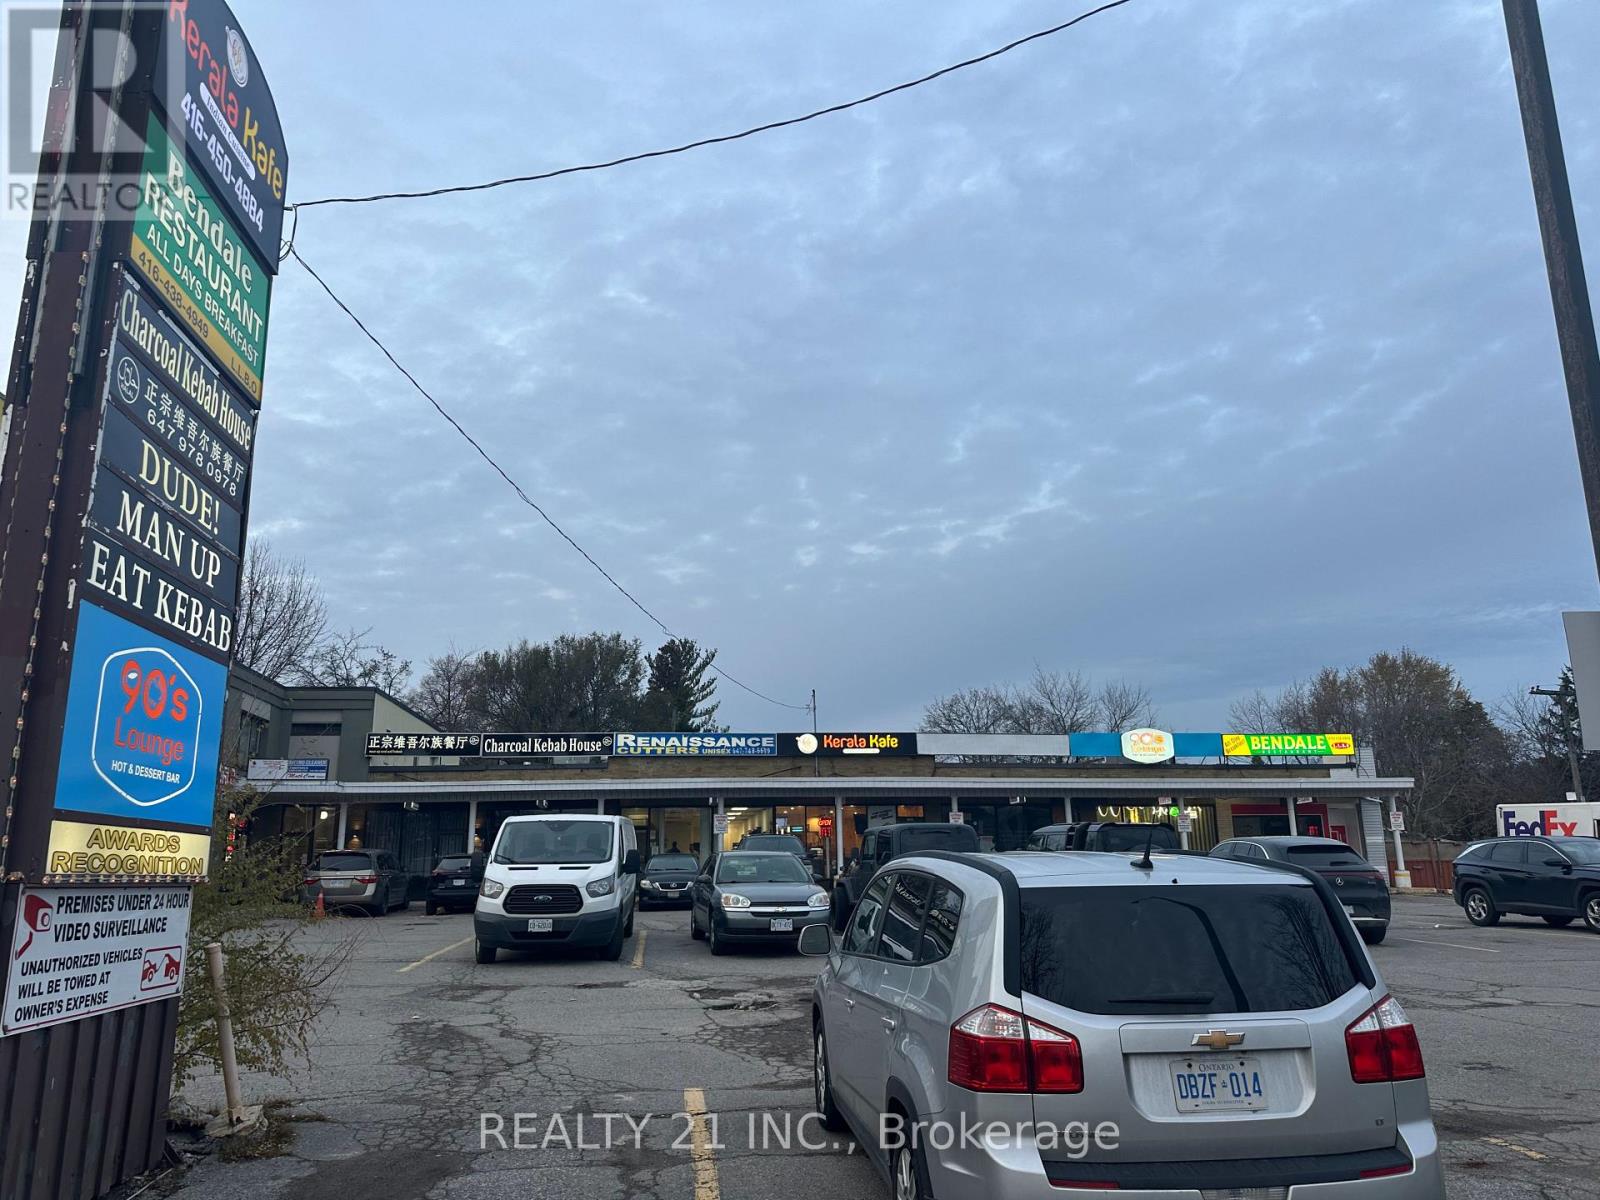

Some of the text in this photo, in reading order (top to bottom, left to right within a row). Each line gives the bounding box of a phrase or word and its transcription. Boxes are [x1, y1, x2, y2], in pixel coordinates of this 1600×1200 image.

[181, 92, 264, 232] 416-450-4884
[244, 107, 282, 199] Kafe
[168, 151, 252, 293] Bendale
[144, 171, 262, 342] RESTAURANT
[139, 251, 209, 338] 416-438-4949
[147, 224, 259, 366] ALL DAYS BREAKFAST
[121, 289, 251, 450] Charcoal Kebab House
[144, 377, 244, 483] 正宗维吾尔族餐厅
[147, 409, 237, 497] 647 978 0978
[139, 439, 220, 535] DUDE!
[117, 490, 221, 588] MAN UP
[87, 541, 231, 652] EAT KEBAB
[121, 659, 189, 722] 90's
[114, 717, 184, 766] Lounge
[368, 735, 468, 749] 正宗维吾尔族餐厅
[484, 737, 602, 753] Charcoal Kebab House
[617, 747, 699, 755] CUTTERS
[823, 734, 899, 748] Kerala Kafe
[1250, 735, 1326, 750] BENDALE
[111, 760, 180, 784] HOT & DESSERT BAR
[1503, 810, 1578, 837] FedEx
[87, 828, 181, 853] AWARDS
[50, 851, 204, 875] RECOGNITION
[56, 892, 190, 915] PREMISES UNDER 24 HOUR
[54, 917, 168, 943] VIDEO SURVEILLANCE
[21, 947, 143, 977] UNAUTHORIZED VEHICLES
[18, 970, 111, 1000] WILL BE TOWED AT
[14, 991, 109, 1023] OWNER'S EXPENSE
[1176, 1071, 1262, 1099] DBZF 014
